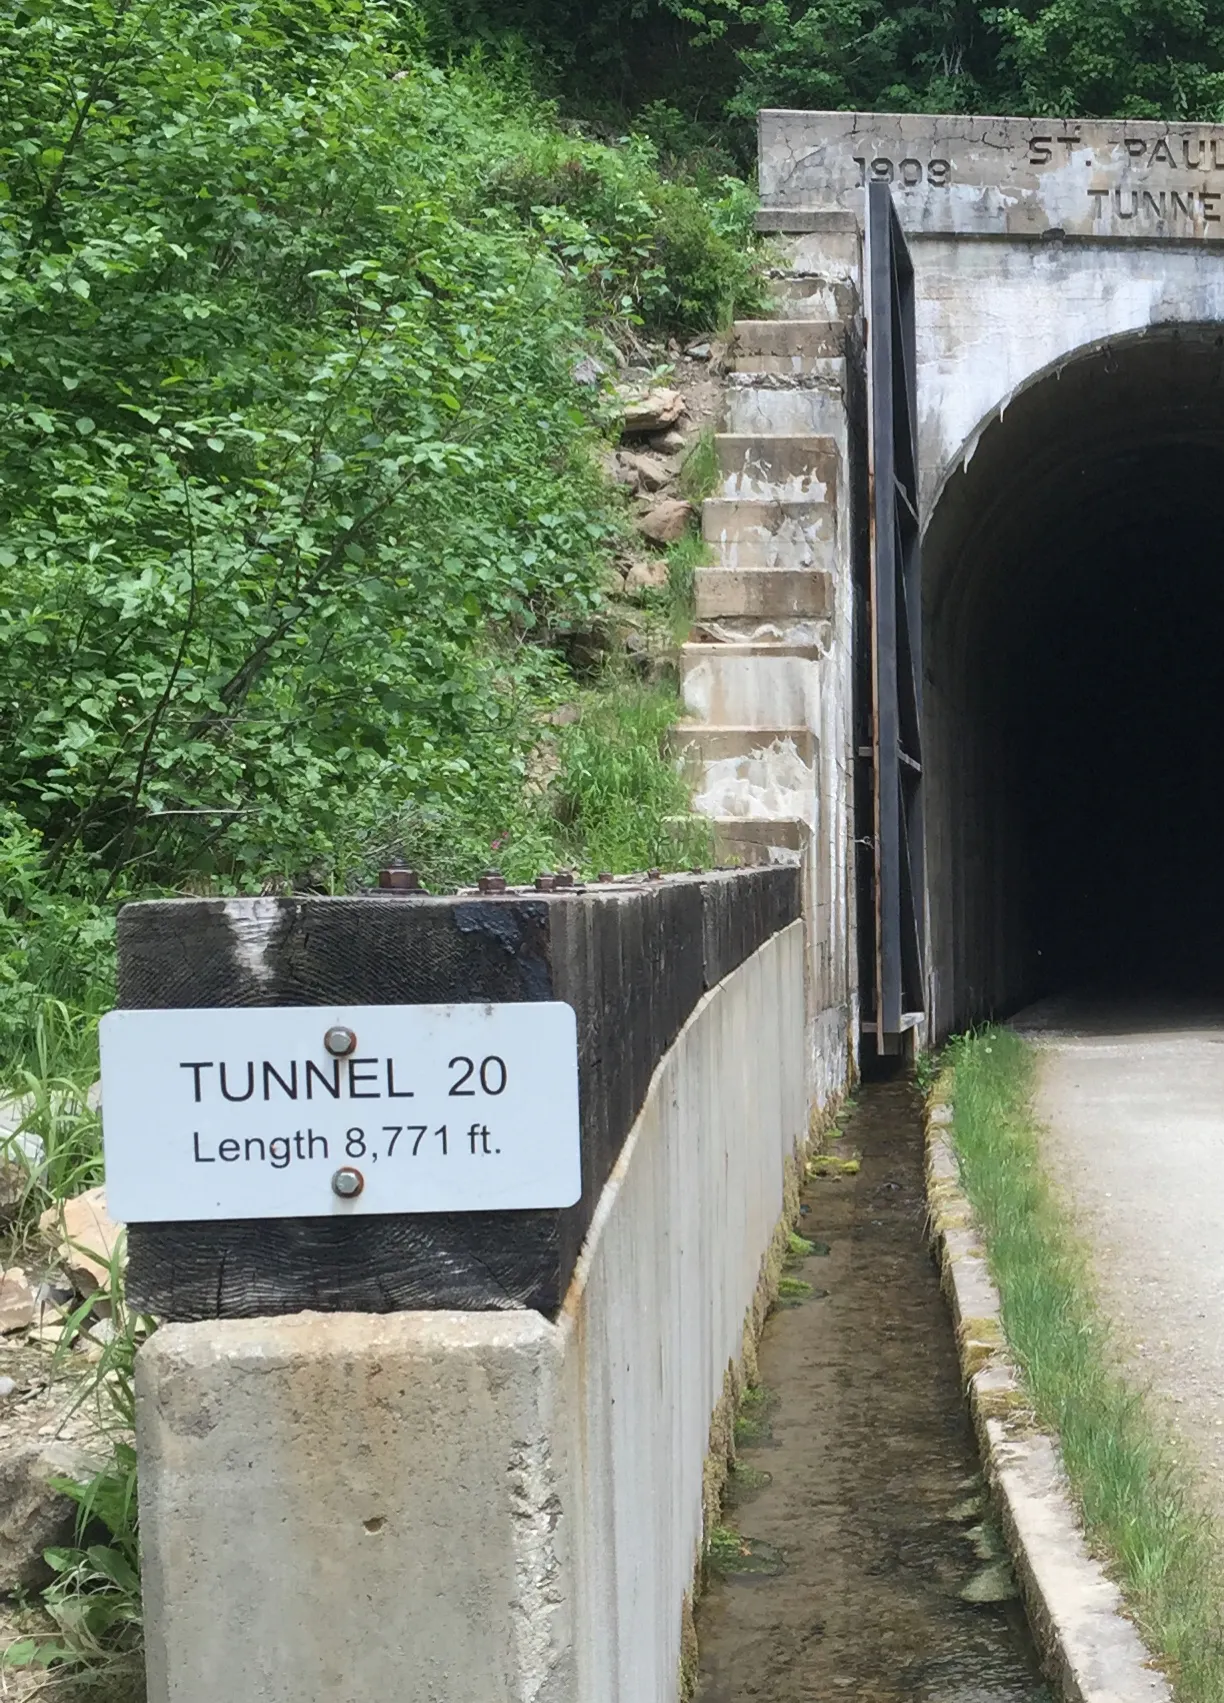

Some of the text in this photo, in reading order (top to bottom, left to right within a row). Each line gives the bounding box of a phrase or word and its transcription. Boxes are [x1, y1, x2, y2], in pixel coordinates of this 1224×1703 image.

[180, 1055, 508, 1102] TUNNEL 20
[193, 1123, 502, 1168] Length 8,771 ft.
